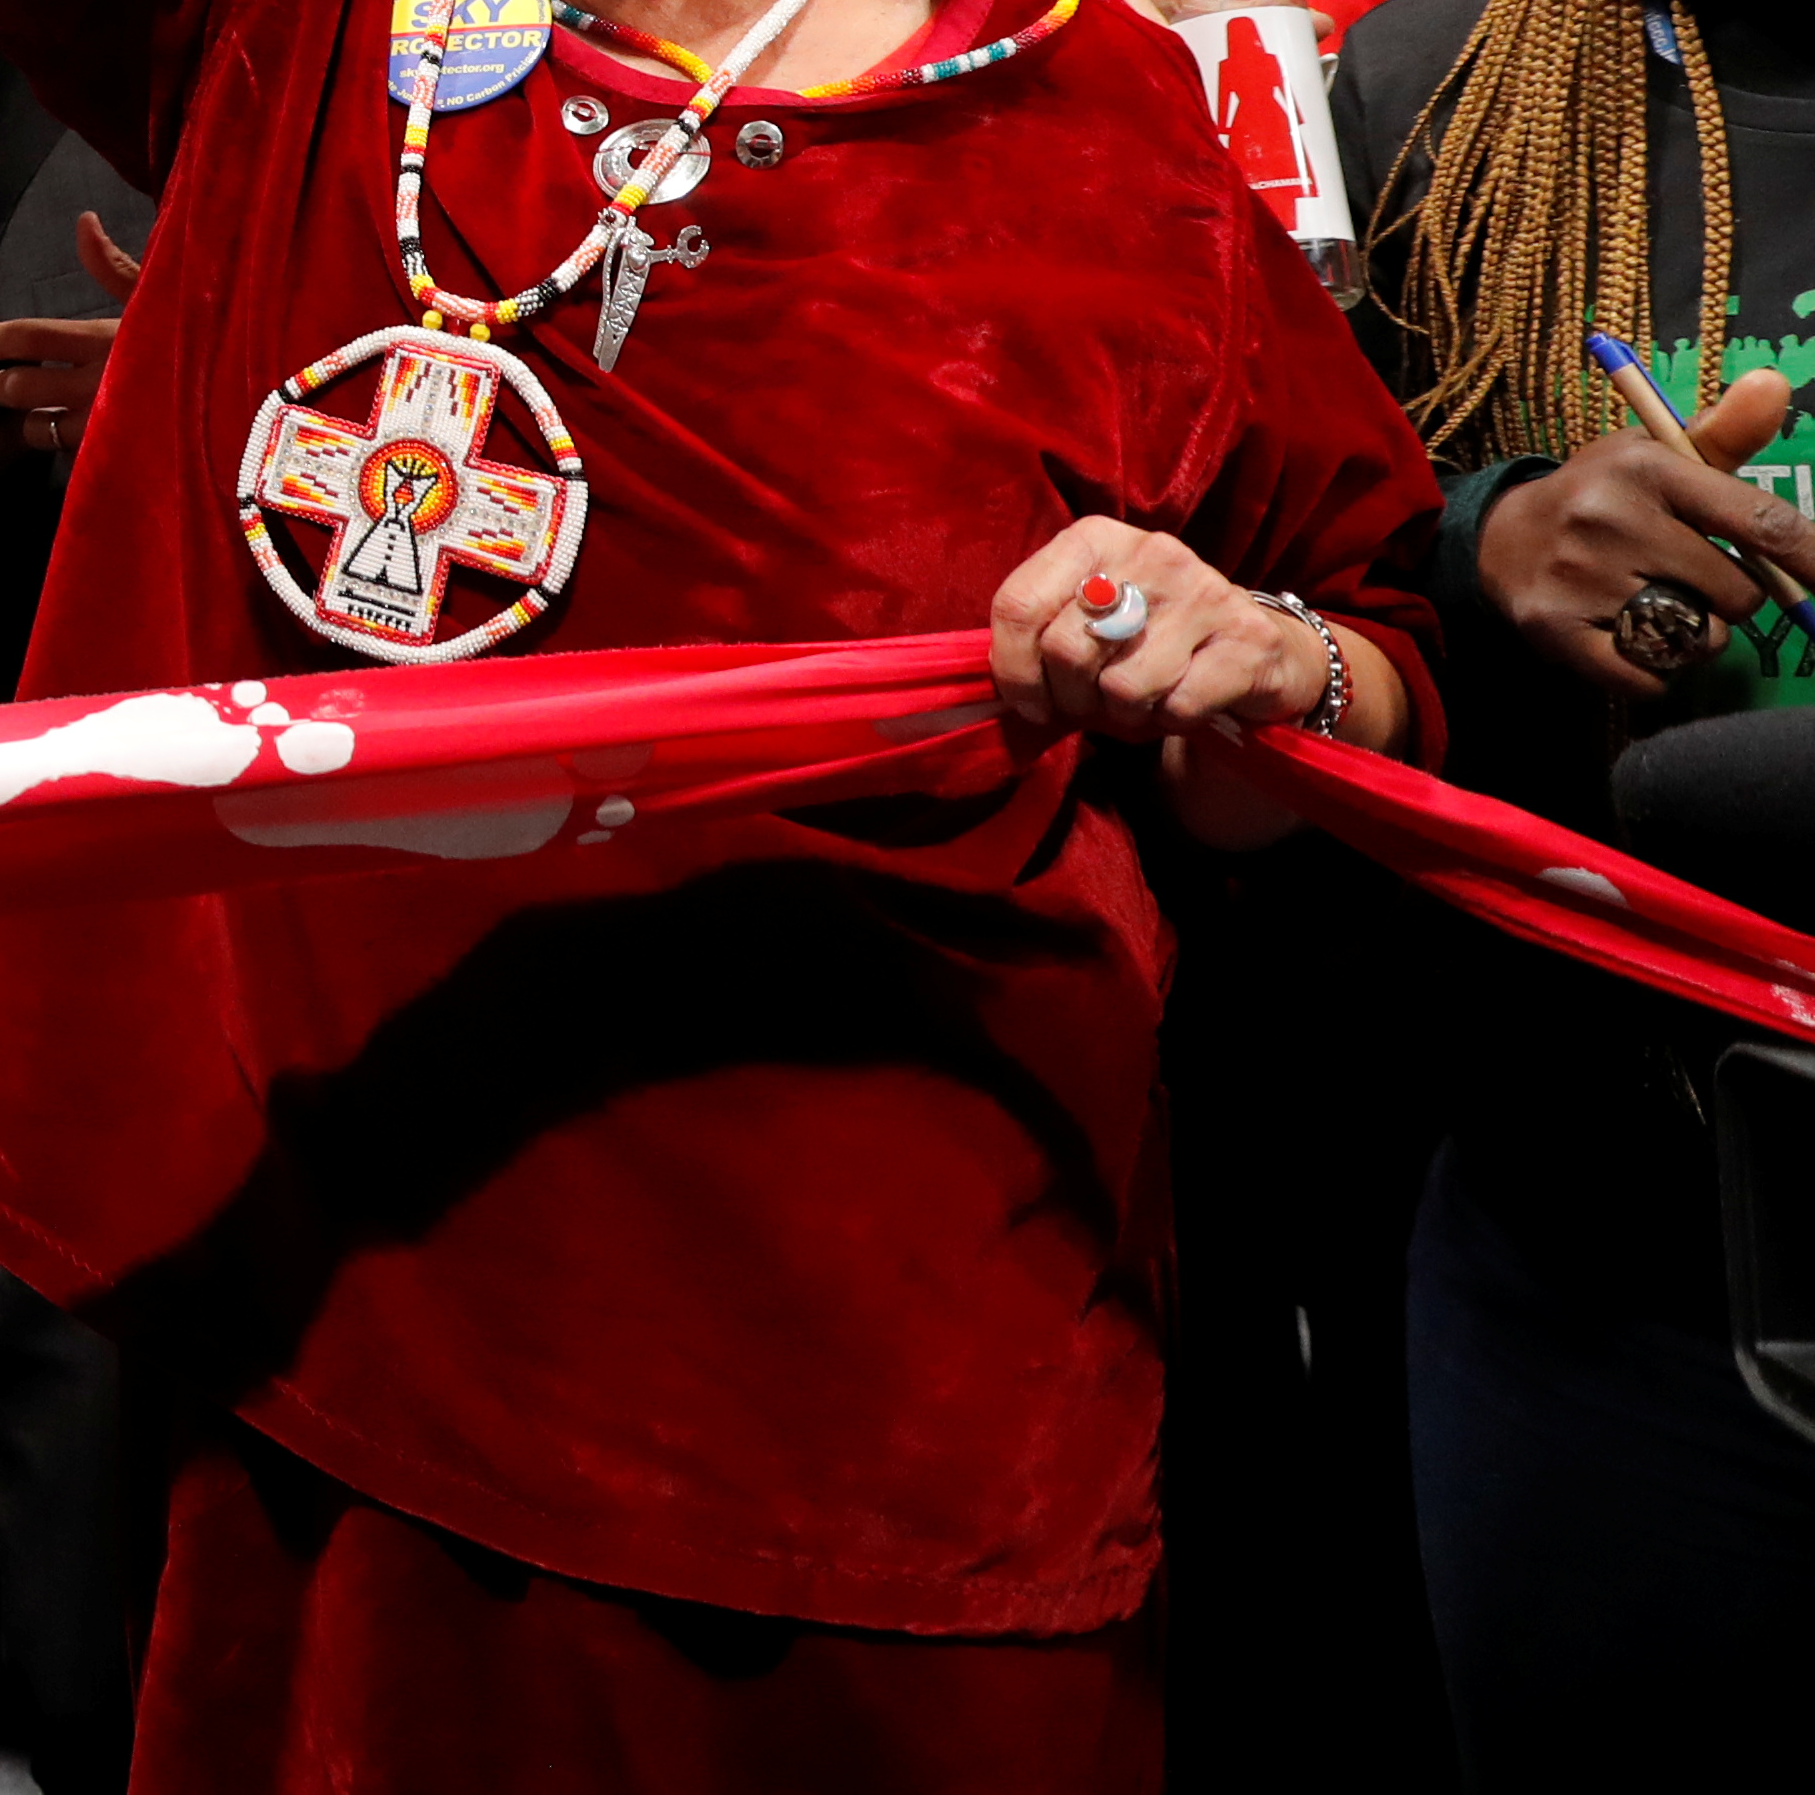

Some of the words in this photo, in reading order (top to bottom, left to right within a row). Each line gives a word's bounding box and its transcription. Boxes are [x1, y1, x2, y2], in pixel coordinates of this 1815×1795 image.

[391, 29, 543, 57] ROECTOR
[399, 62, 506, 80] skytector.org
[446, 95, 464, 106] NO
[466, 80, 506, 102] Carbon
